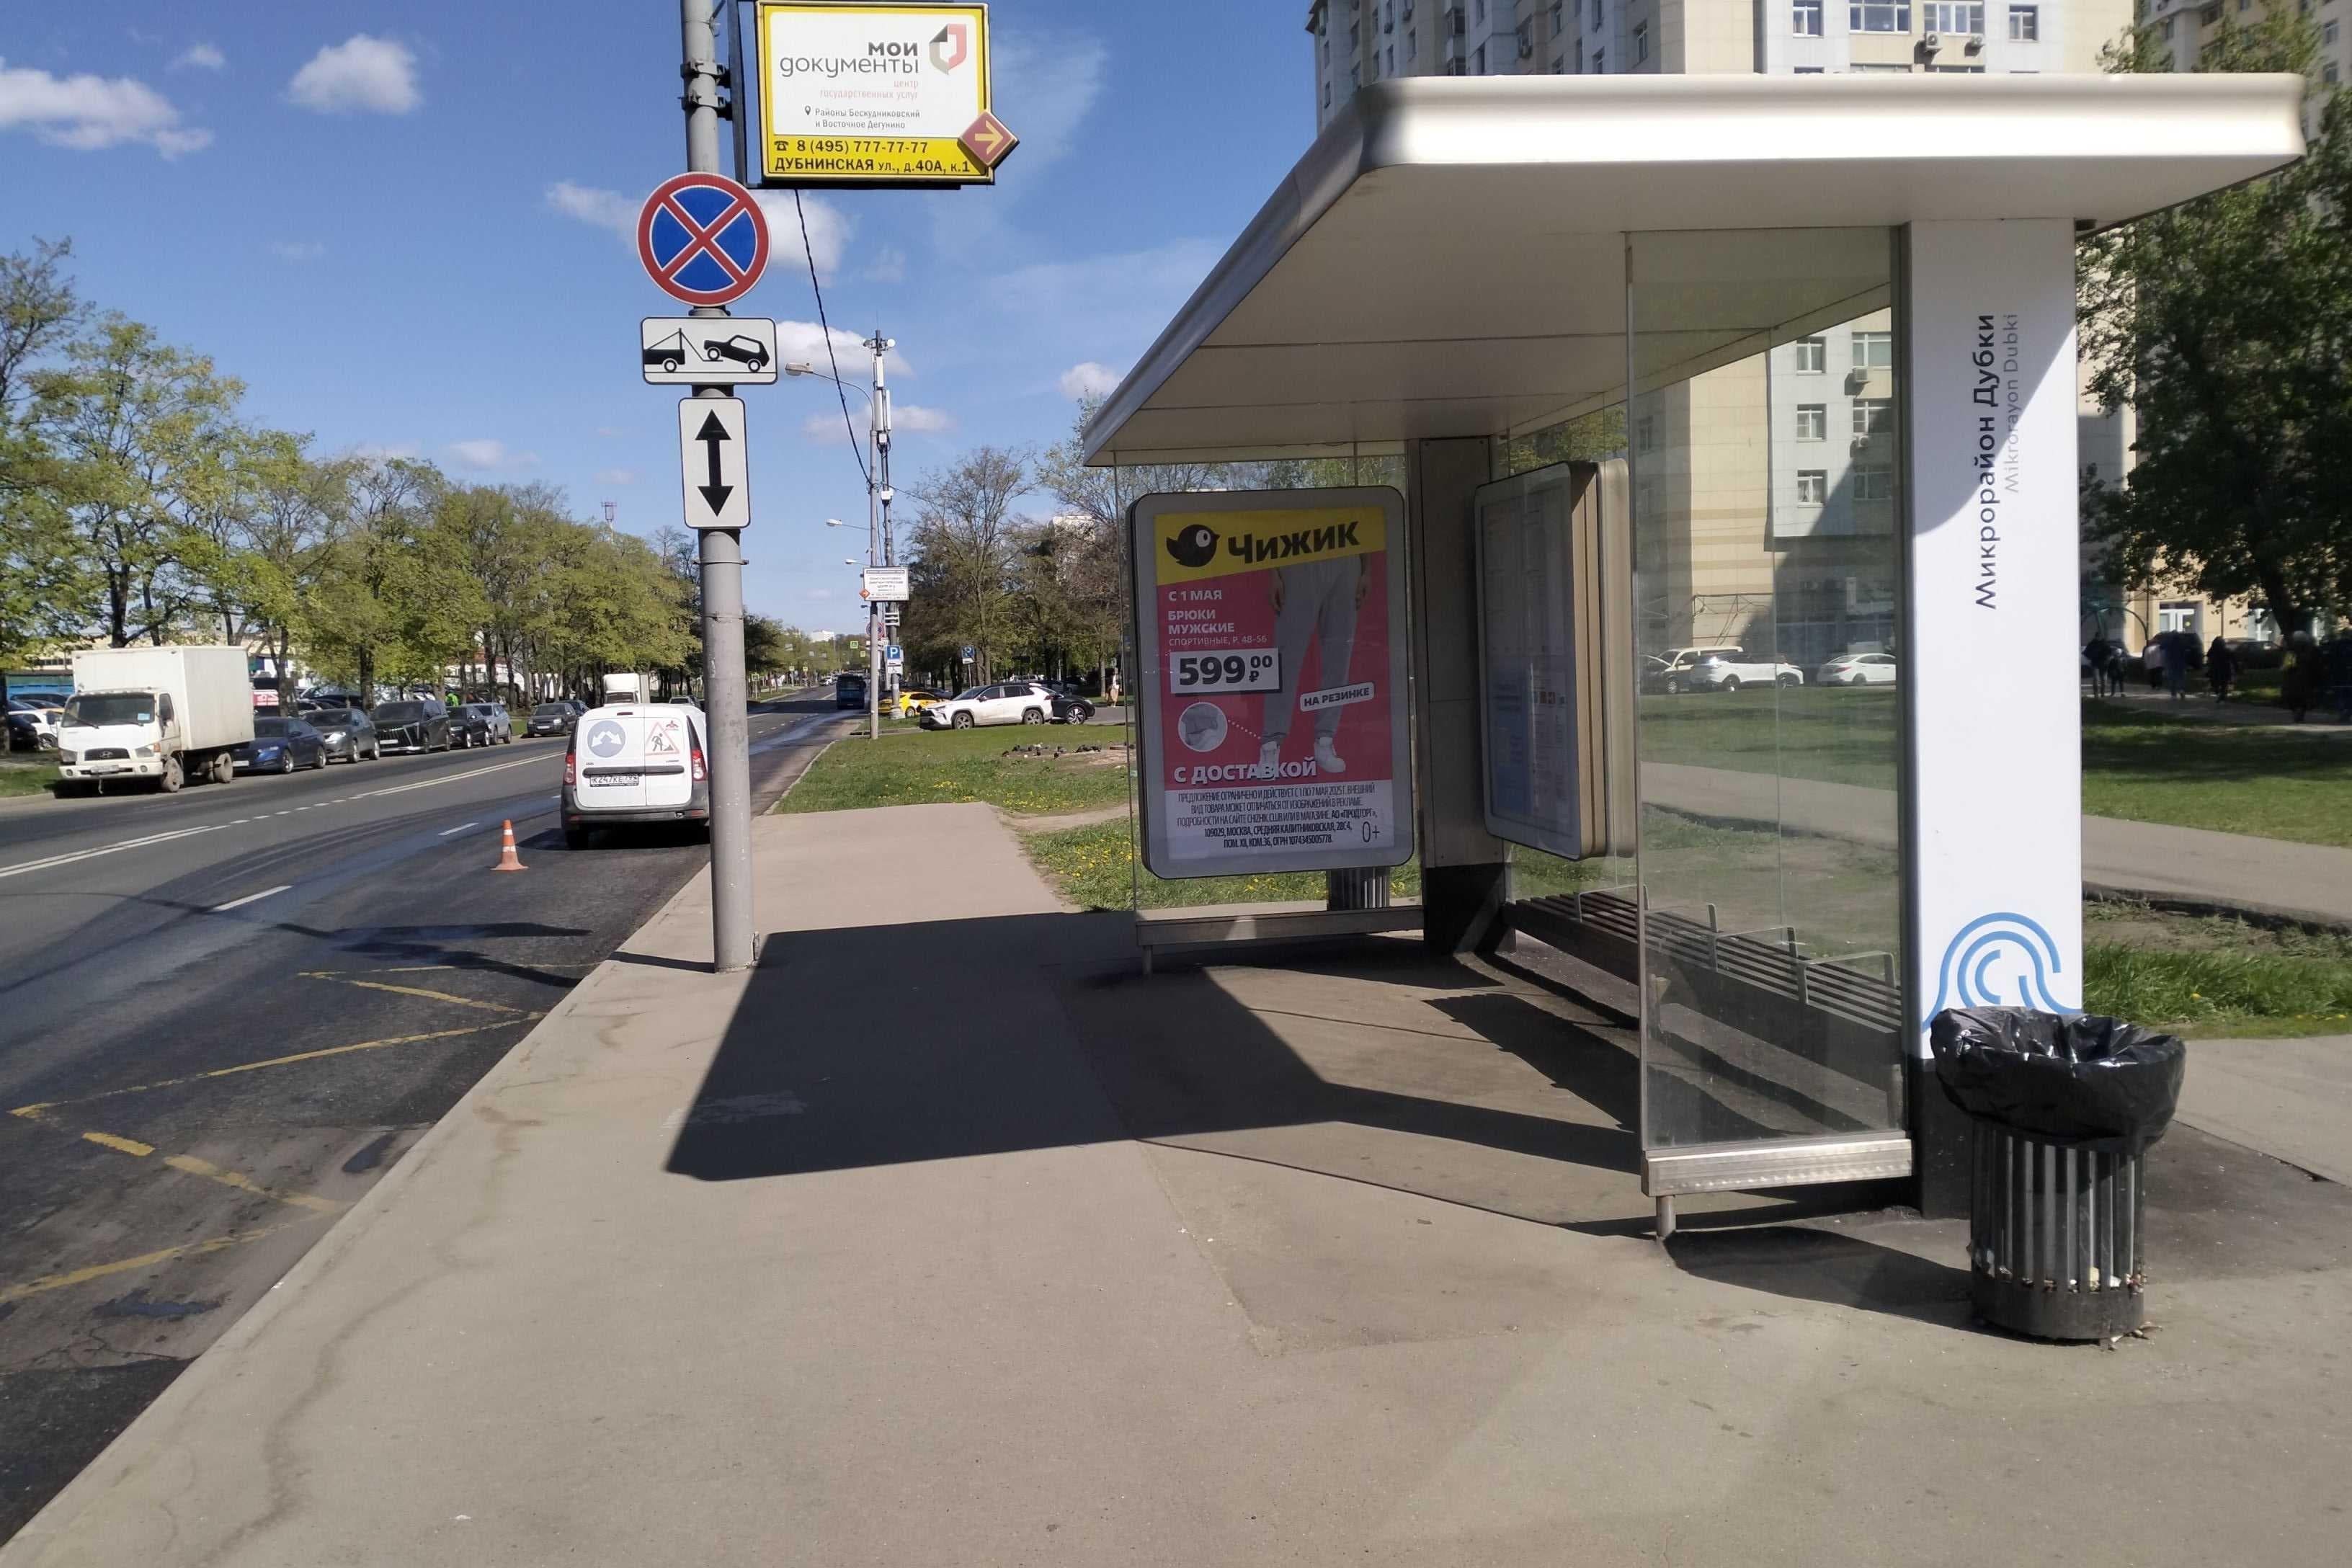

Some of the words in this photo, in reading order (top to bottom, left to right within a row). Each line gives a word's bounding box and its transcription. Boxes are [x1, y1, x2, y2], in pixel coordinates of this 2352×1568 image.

[779, 57, 919, 79] документы
[894, 80, 919, 89] центр
[819, 89, 894, 99] государственных
[896, 92, 918, 101] услуг
[814, 108, 847, 117] Районы
[849, 109, 920, 118] Бескудниковский
[822, 119, 865, 128] Восточное
[867, 120, 906, 130] Дегунино
[796, 140, 806, 151] 8
[809, 139, 849, 154] (495)
[852, 140, 928, 153] 777-77-77
[774, 157, 874, 172] ДУБНИНСКАЯ
[878, 162, 900, 173] ул.,
[903, 160, 946, 175] д.40А,
[950, 161, 970, 173] к.1
[2003, 313, 2019, 373] Dubki
[1972, 314, 2001, 408] Дубки
[2004, 377, 2023, 494] Mikrorayon
[1973, 416, 2001, 610] Микрорайон
[1168, 589, 1177, 602] С
[1180, 589, 1188, 602] 1
[1190, 589, 1223, 601] МАЯ
[1167, 609, 1216, 621] БРЮКИ
[1168, 622, 1235, 635] МУЖСКИЕ
[1168, 636, 1231, 646] СПОРТИВНЫЕ,
[1242, 634, 1268, 644] 48-56
[1179, 655, 1246, 686] 599
[1250, 655, 1273, 669] 00
[1304, 696, 1320, 708] НА
[1322, 687, 1371, 704] РЕЗИНКЕ
[1173, 766, 1187, 784] С
[1190, 756, 1318, 785] ДОСТАВКОЙ
[1178, 791, 1219, 803] ПРЕДЛОЖЕНИЕ
[1221, 789, 1257, 801] ОГРАНИЧЕНО
[1362, 821, 1380, 843] 0+
